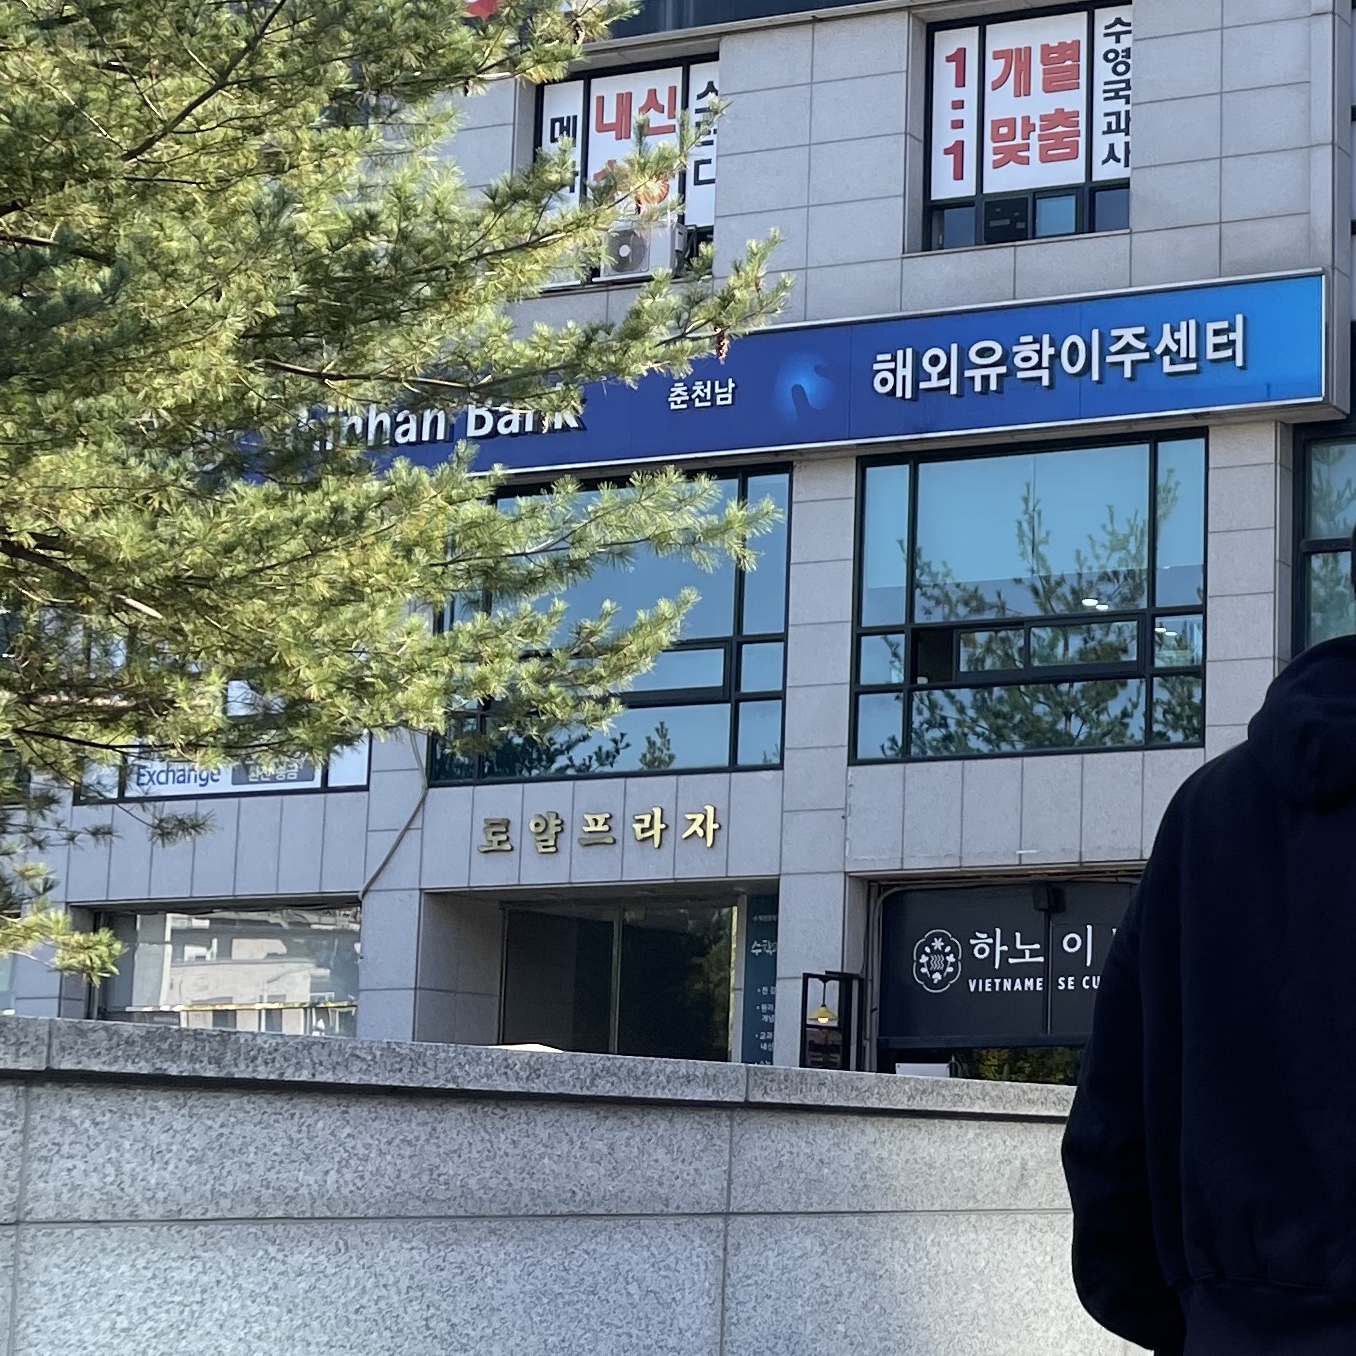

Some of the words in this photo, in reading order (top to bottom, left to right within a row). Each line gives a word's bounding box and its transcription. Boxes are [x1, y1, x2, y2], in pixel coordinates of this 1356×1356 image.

[991, 40, 1080, 97] 개별
[595, 86, 677, 140] 내신
[943, 47, 966, 181] 1:1
[990, 108, 1081, 169] 맞춤
[872, 313, 1246, 400] 해외유학이주센터
[667, 378, 736, 410] 춘천남
[297, 401, 447, 452] inhan
[136, 765, 221, 787] Exchange
[477, 804, 721, 854] 로얄프라자
[1082, 974, 1101, 990] CU
